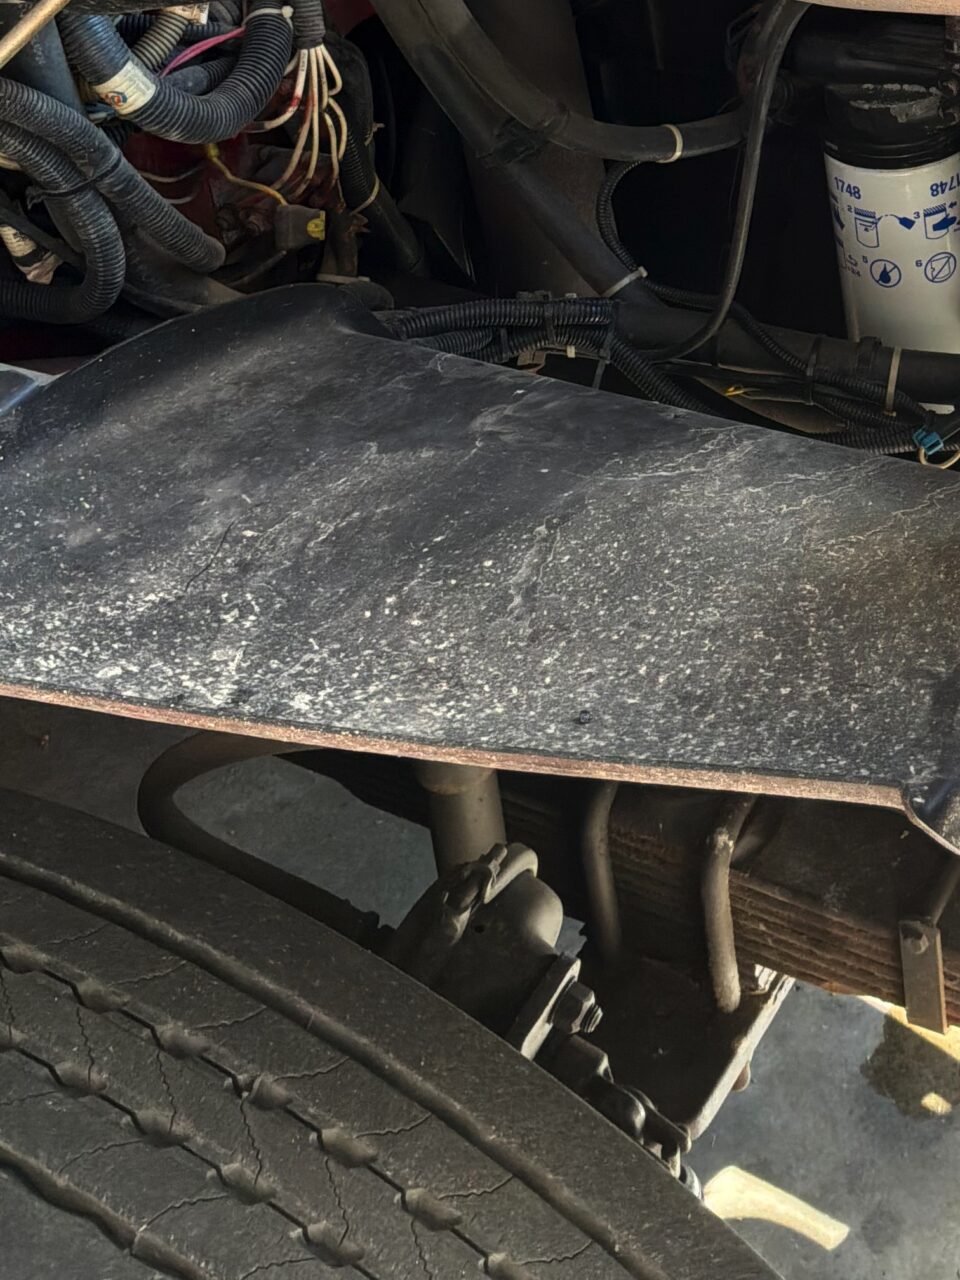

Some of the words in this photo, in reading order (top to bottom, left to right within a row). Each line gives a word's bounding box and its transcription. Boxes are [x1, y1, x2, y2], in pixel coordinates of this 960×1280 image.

[834, 175, 862, 200] 1748
[913, 210, 921, 221] 3
[914, 258, 923, 269] 6
